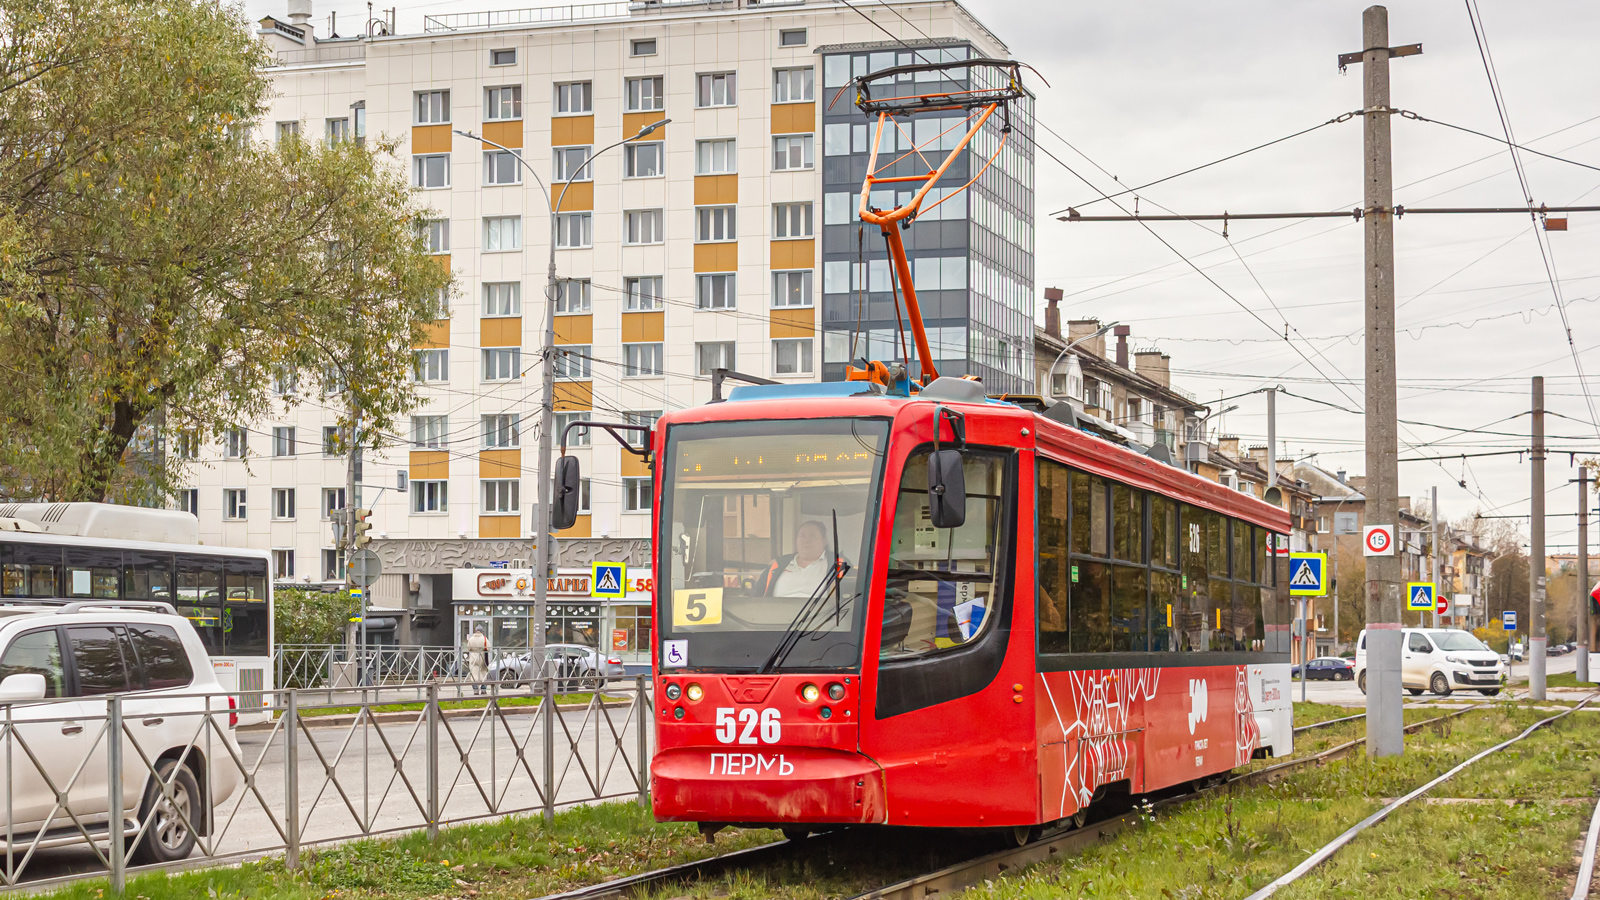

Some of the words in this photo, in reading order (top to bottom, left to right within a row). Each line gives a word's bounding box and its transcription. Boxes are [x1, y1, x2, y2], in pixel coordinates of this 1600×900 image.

[1189, 522, 1200, 553] 526
[1372, 535, 1385, 546] 15
[685, 593, 707, 622] 5
[715, 707, 782, 744] 526
[709, 752, 794, 776] ПЕРМЬ
